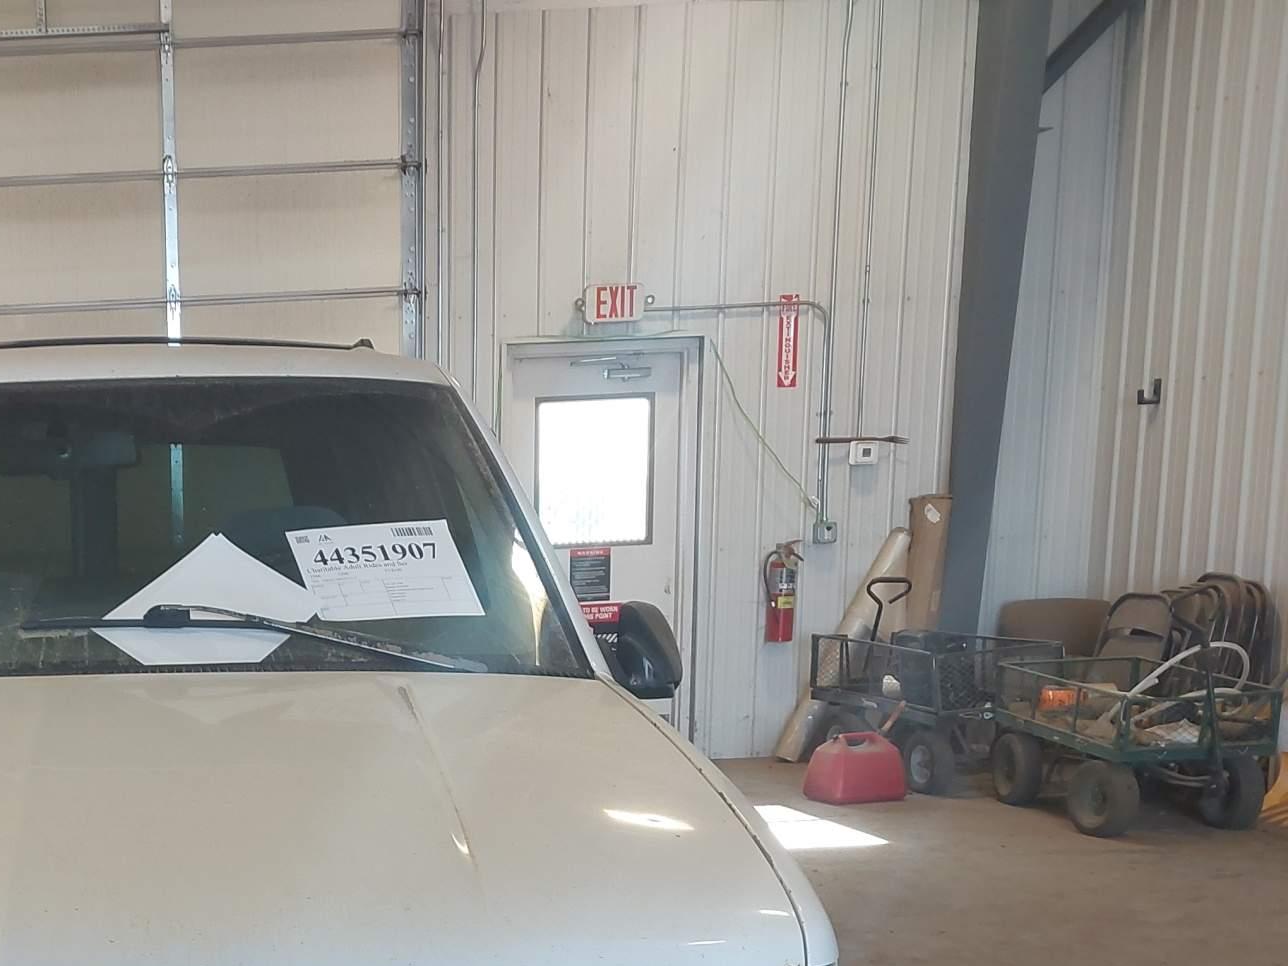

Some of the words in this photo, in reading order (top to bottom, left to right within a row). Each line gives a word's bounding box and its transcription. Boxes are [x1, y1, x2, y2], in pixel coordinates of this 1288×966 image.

[596, 285, 637, 320] EXIT
[783, 316, 792, 380] EXTINGUISHER
[313, 542, 437, 566] 44351907
